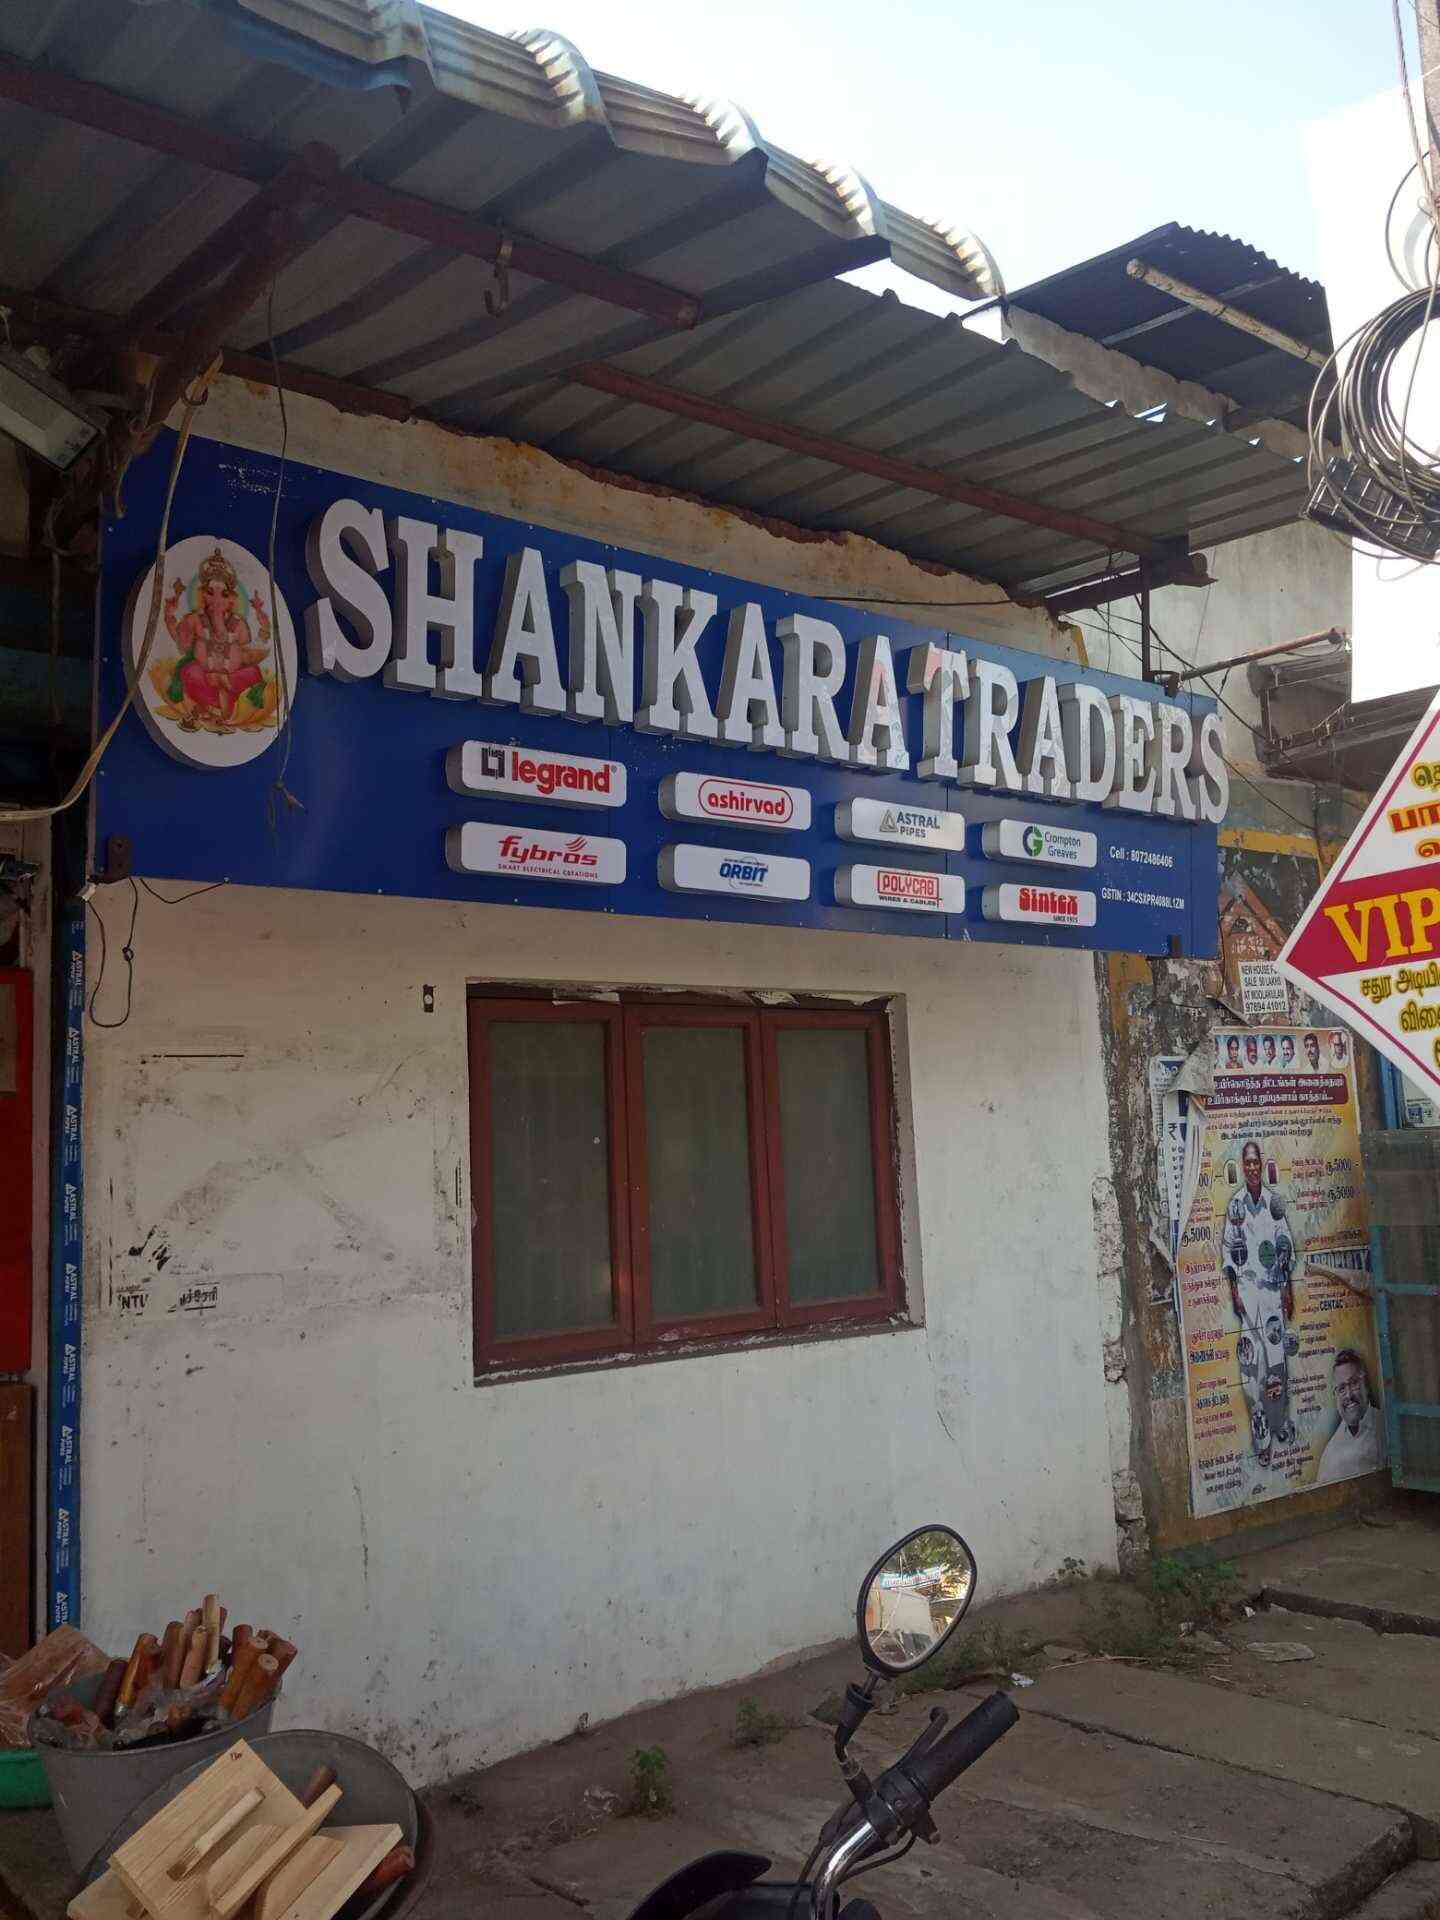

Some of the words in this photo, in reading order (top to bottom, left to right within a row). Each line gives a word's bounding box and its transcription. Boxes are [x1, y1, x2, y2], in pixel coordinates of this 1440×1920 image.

[305, 499, 910, 773] SHANKARA
[908, 642, 1230, 824] TRADERS
[512, 751, 610, 794] legrand
[708, 790, 785, 815] ashirvad
[897, 811, 941, 829] ASTRAL
[900, 826, 926, 838] PIPES
[1044, 831, 1081, 847] Crompton
[498, 836, 598, 865] fybros
[1048, 845, 1078, 860] Greaves
[1109, 846, 1125, 859] Cell
[719, 863, 769, 882] ORBIT
[882, 874, 935, 896] POLYCAB
[1101, 887, 1122, 901] GSTIN
[1019, 887, 1078, 915] Sintex
